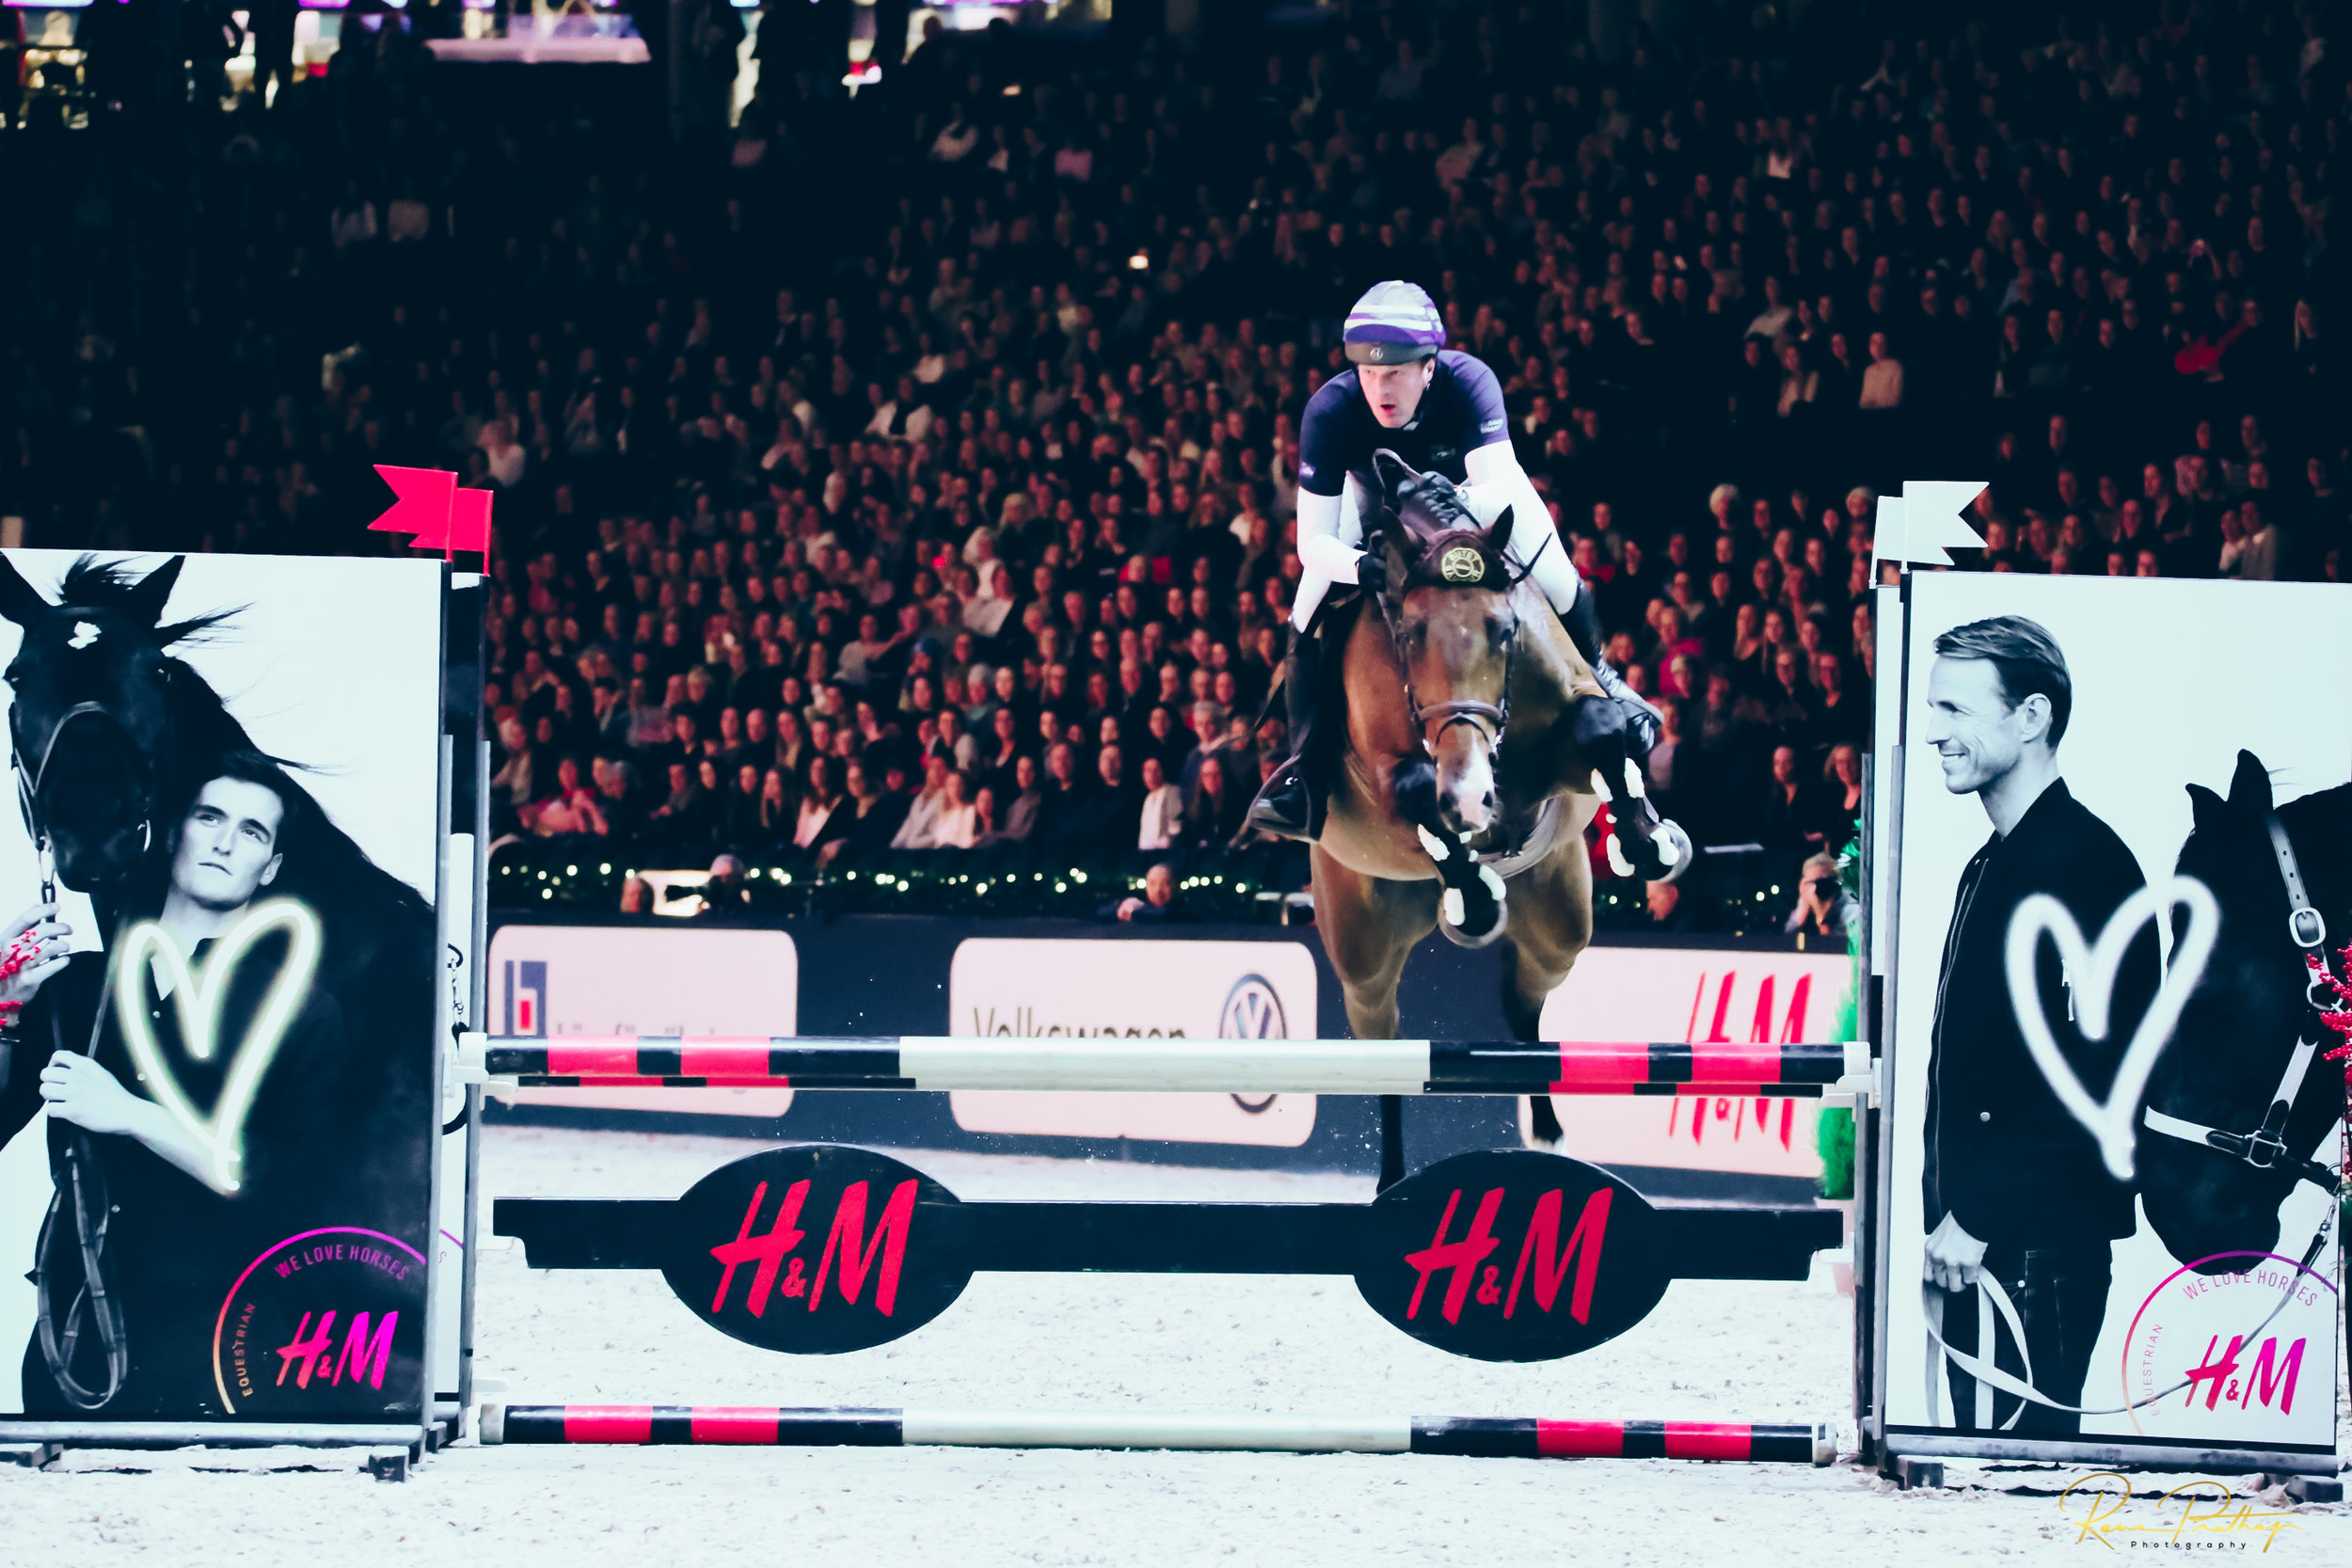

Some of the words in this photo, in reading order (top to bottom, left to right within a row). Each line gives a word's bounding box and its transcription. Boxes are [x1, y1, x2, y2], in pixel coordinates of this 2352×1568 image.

[275, 1256, 302, 1278] WE
[303, 1244, 344, 1265] LOVE
[349, 1244, 410, 1281] HORSES
[709, 1179, 919, 1319] H&M
[1404, 1186, 1614, 1326] H&M
[2183, 1277, 2209, 1300] WE
[2212, 1270, 2251, 1288] LOVE
[2257, 1269, 2318, 1307] HORSES
[234, 1303, 256, 1397] EQUESTRIAN
[276, 1310, 399, 1390] H&M
[2185, 1334, 2307, 1416] H&M
